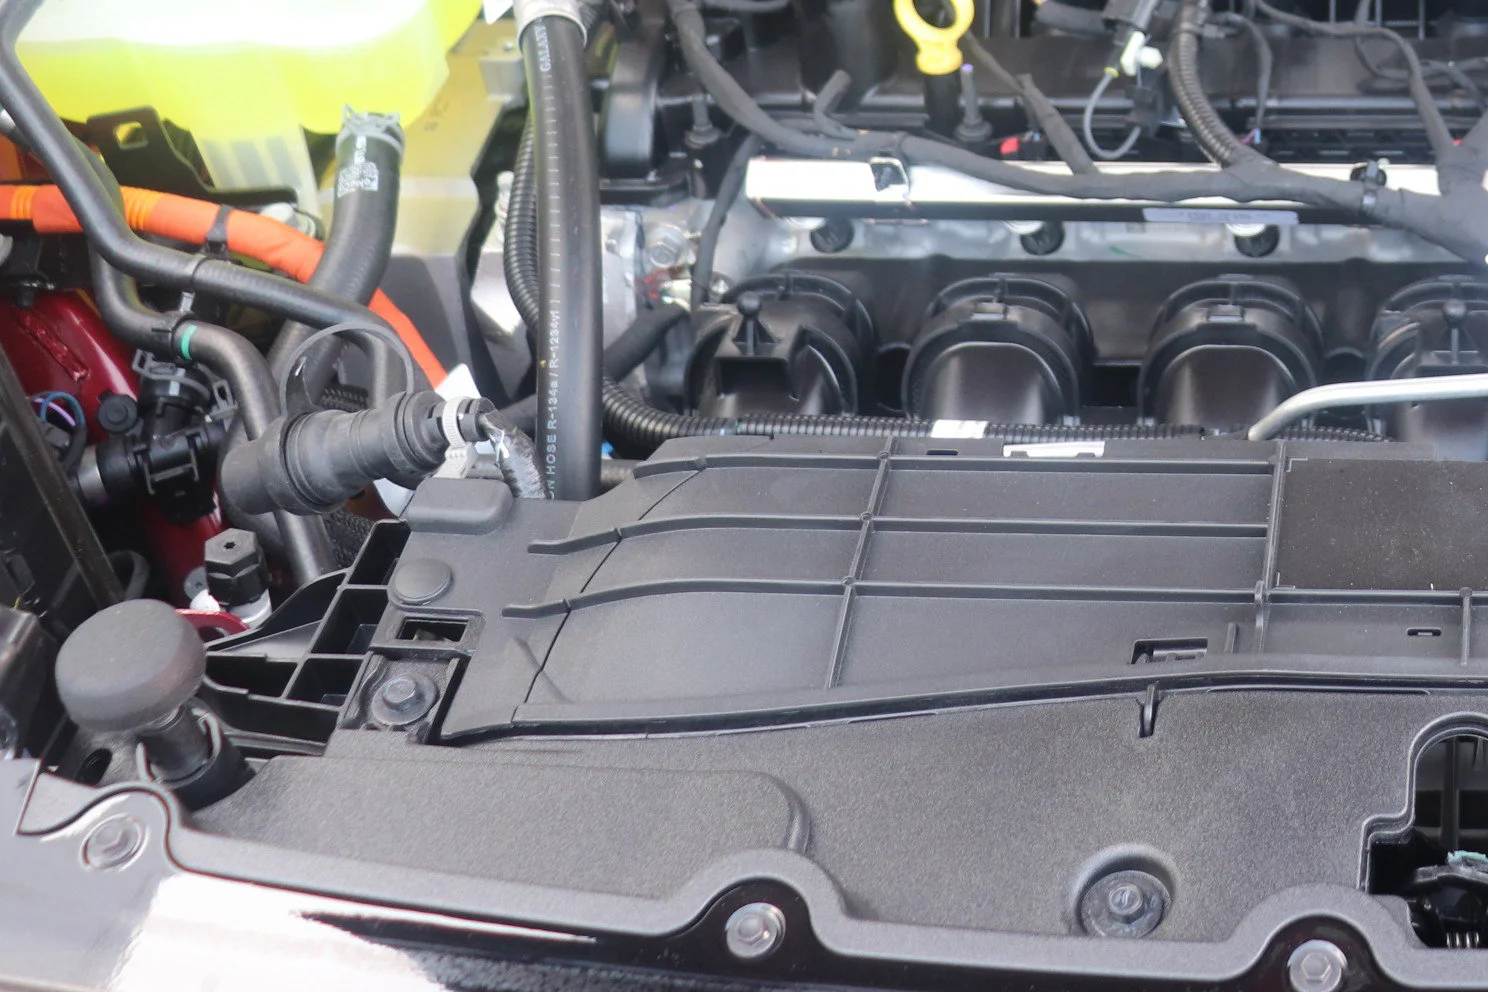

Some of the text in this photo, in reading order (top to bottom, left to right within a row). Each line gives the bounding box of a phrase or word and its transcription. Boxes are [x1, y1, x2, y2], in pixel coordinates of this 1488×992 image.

[534, 24, 552, 72] GALAXY
[547, 379, 558, 429] R-134a
[546, 433, 557, 475] HOSE
